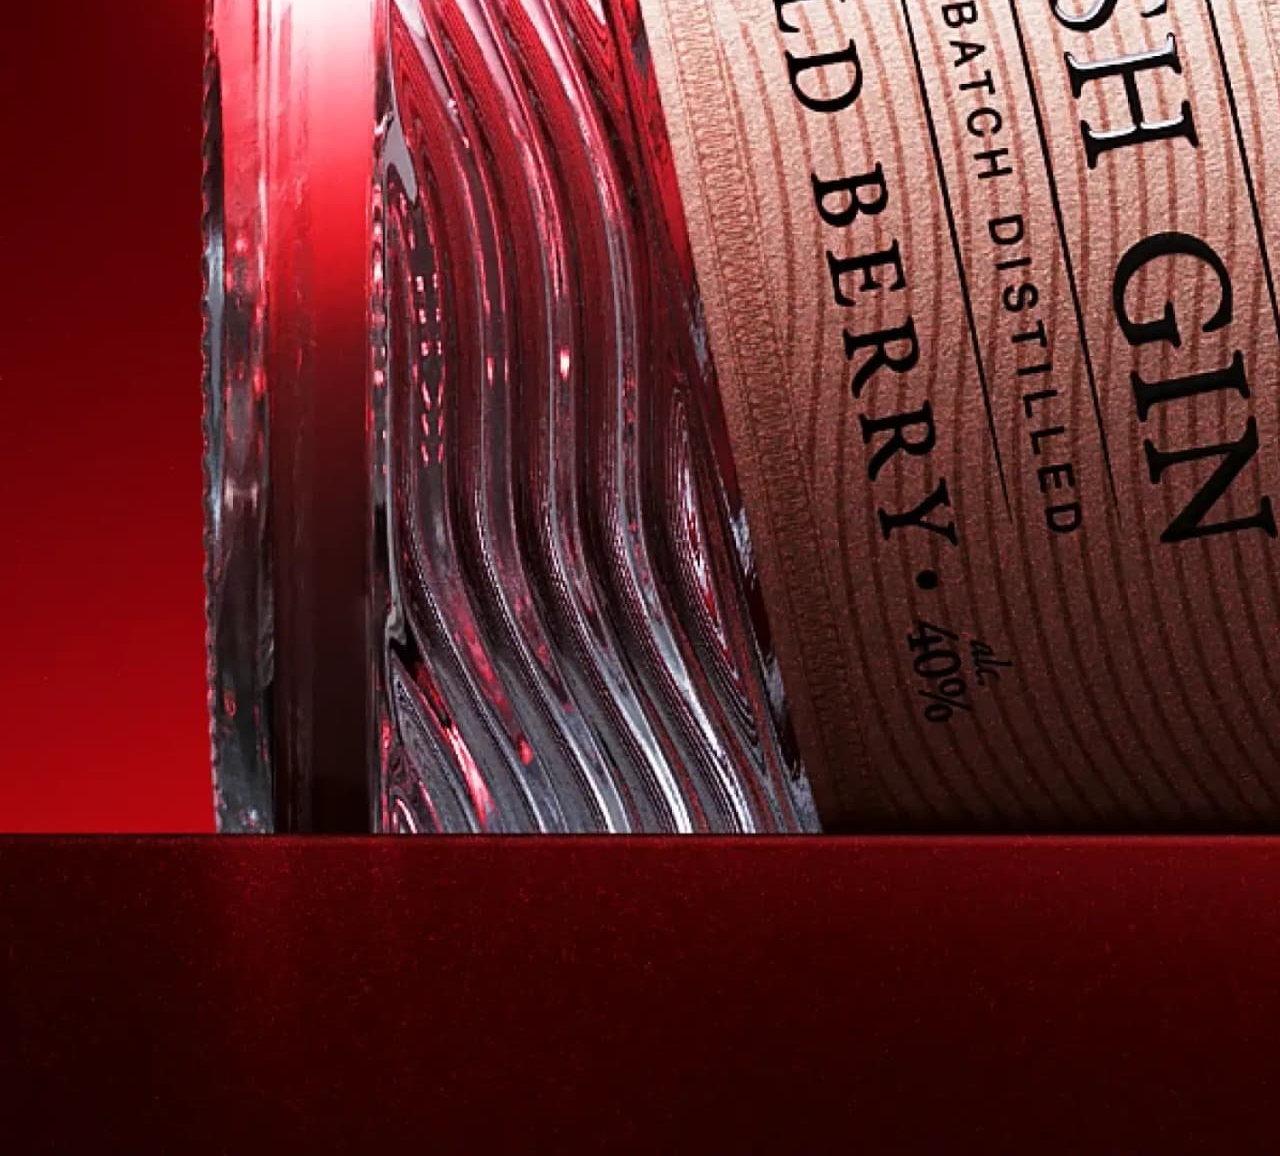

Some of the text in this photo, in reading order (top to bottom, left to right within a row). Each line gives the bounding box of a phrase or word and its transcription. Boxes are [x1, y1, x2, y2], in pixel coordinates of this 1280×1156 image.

[810, 162, 959, 546] BERRY
[907, 620, 974, 724] 40%
[942, 0, 1014, 180] BATCH
[988, 213, 1084, 534] DISTILLED
[1112, 231, 1278, 545] GIN
